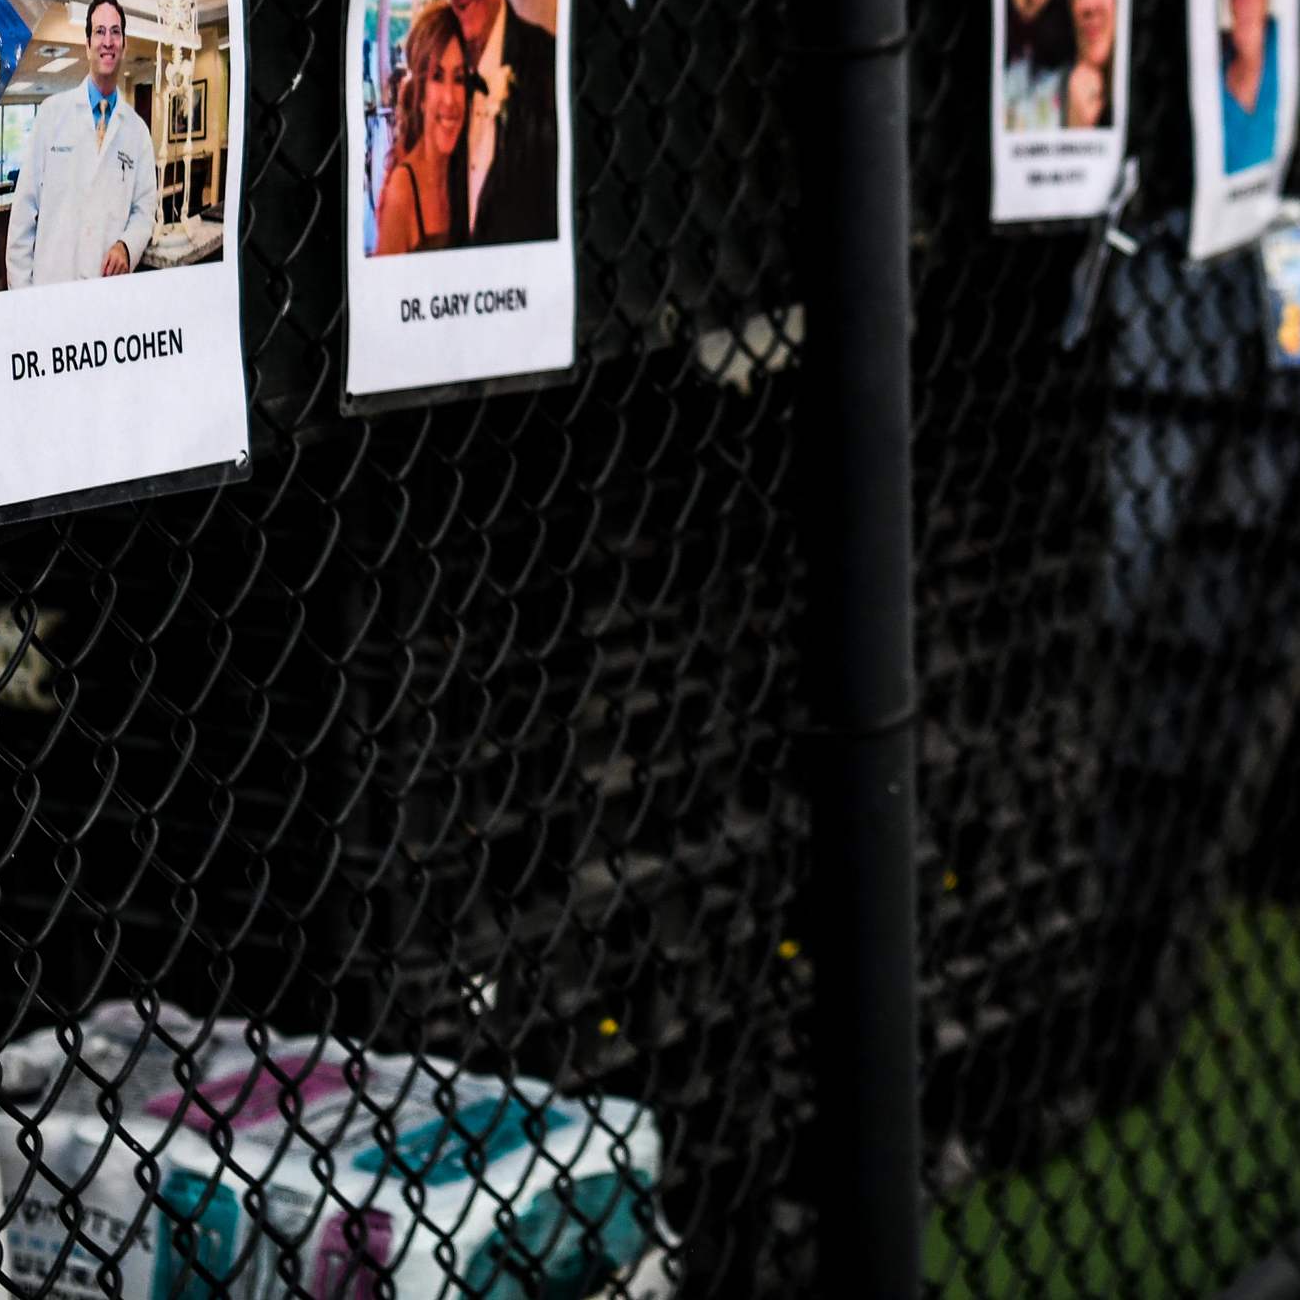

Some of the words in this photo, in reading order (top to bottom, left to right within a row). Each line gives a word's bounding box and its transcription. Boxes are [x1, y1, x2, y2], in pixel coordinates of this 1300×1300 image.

[398, 297, 426, 322] DR.
[429, 293, 470, 320] GARY
[475, 287, 528, 315] COHEN
[11, 350, 46, 381] DR.
[52, 340, 108, 375] BRAD
[113, 327, 184, 364] COHEN
